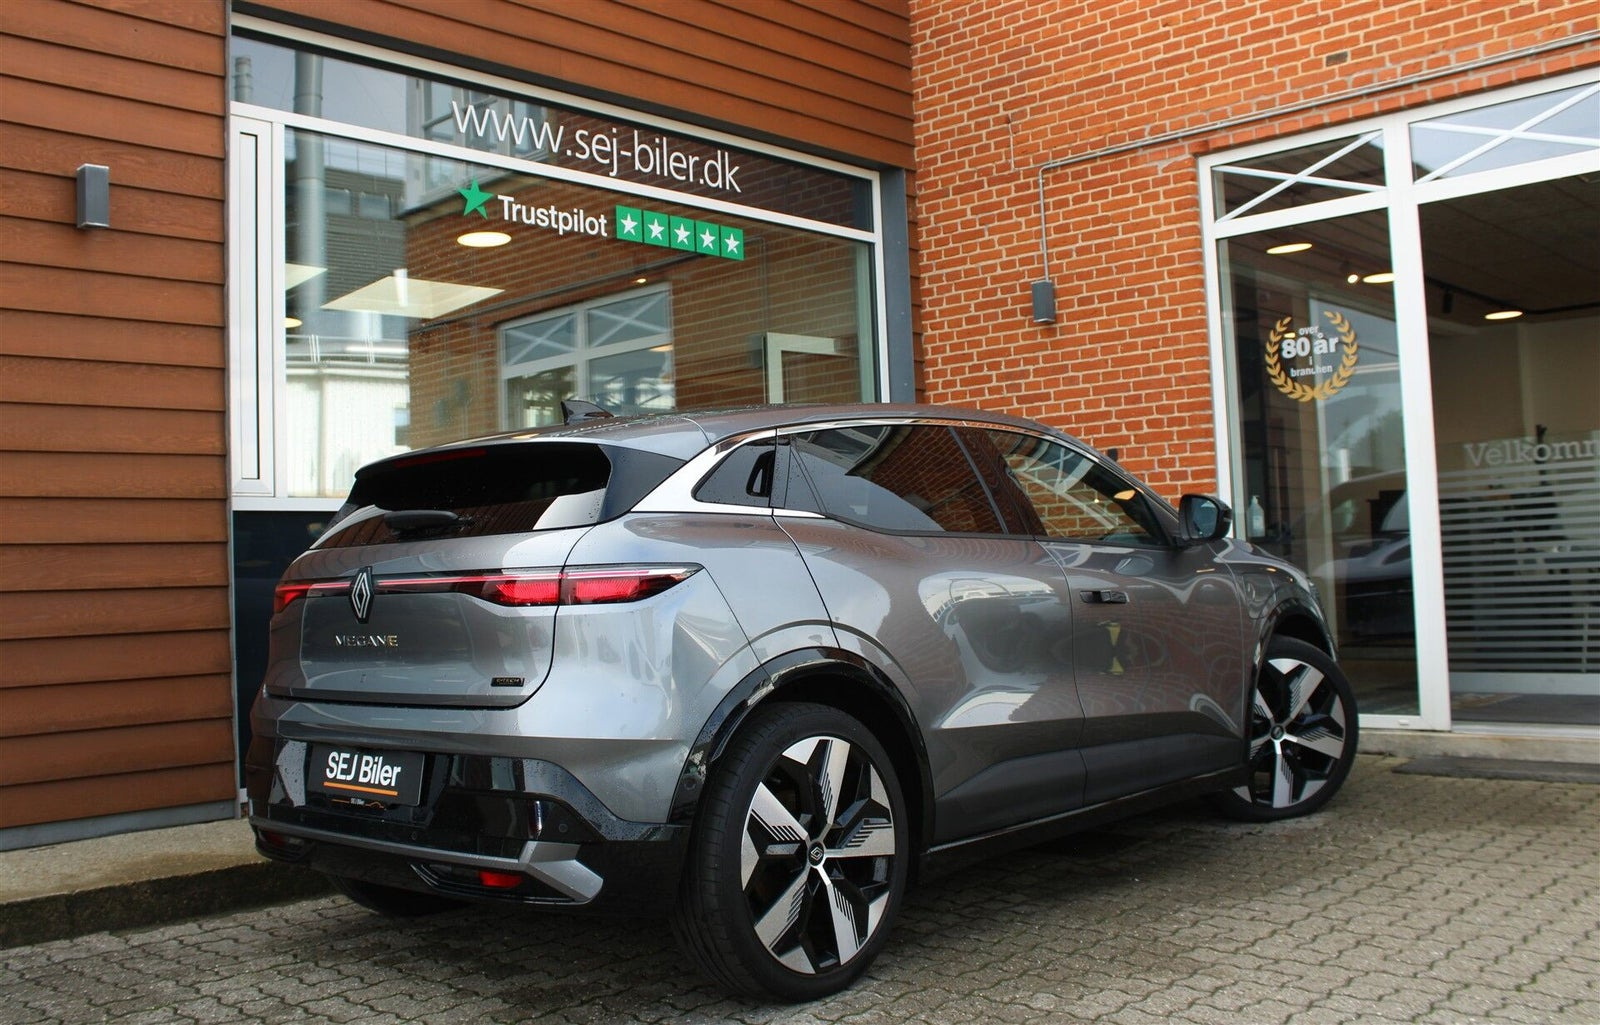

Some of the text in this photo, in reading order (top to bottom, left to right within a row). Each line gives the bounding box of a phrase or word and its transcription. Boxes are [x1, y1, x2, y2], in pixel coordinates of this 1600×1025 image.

[452, 100, 742, 193] www.sej-biler.dk
[497, 194, 607, 237] Trustpilot
[1281, 332, 1339, 359] 80 år
[1298, 325, 1319, 336] over
[335, 635, 399, 647] MEGANE
[325, 751, 402, 787] SEJ Biler
